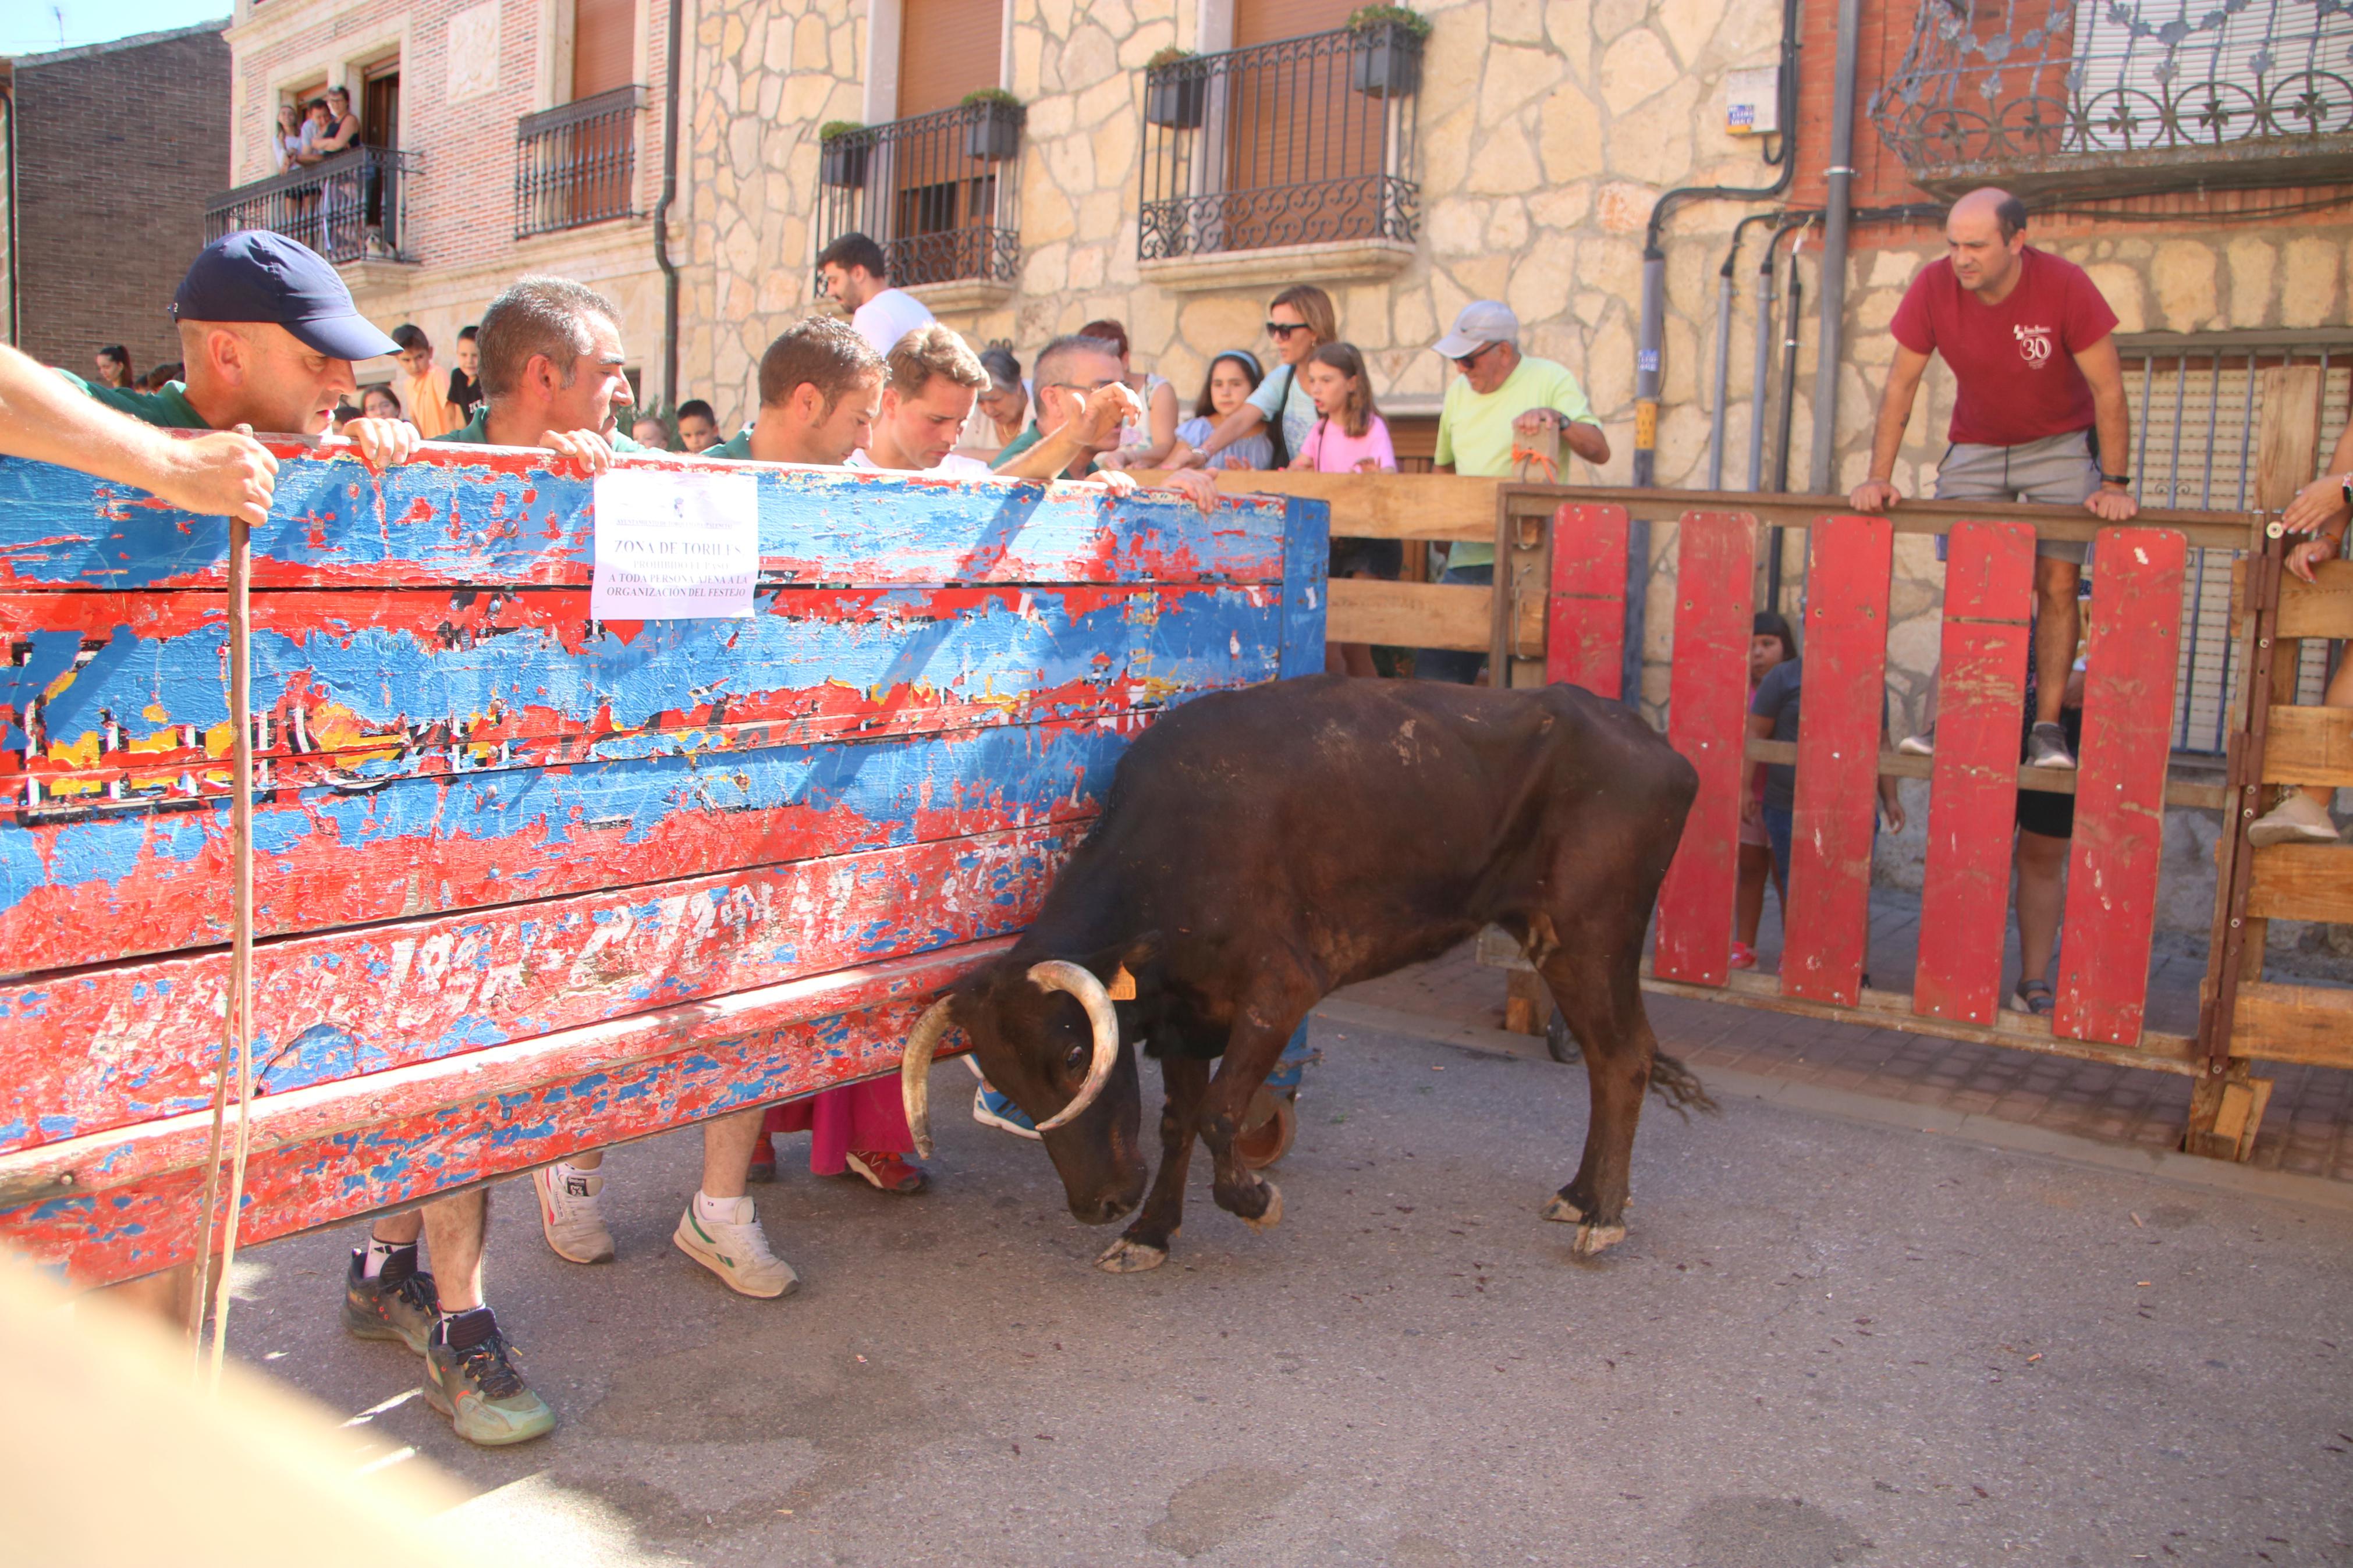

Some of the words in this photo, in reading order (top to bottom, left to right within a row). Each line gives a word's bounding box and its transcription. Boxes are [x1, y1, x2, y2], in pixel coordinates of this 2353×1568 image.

[2022, 337, 2049, 361] 30
[615, 540, 655, 553] ZONA
[660, 542, 677, 554] DE
[682, 542, 742, 556] TORILES
[634, 560, 688, 568] PROHIBIDO
[704, 561, 729, 570] PASO
[609, 573, 616, 582] A
[619, 573, 647, 582] TODA
[650, 574, 694, 583] PERSONA
[698, 575, 726, 584] AJENA
[727, 575, 734, 584] A
[736, 575, 747, 584] LA
[606, 585, 687, 597] ORGANIZACIÓN
[688, 588, 706, 597] DEL
[708, 588, 746, 597] FESTEJO
